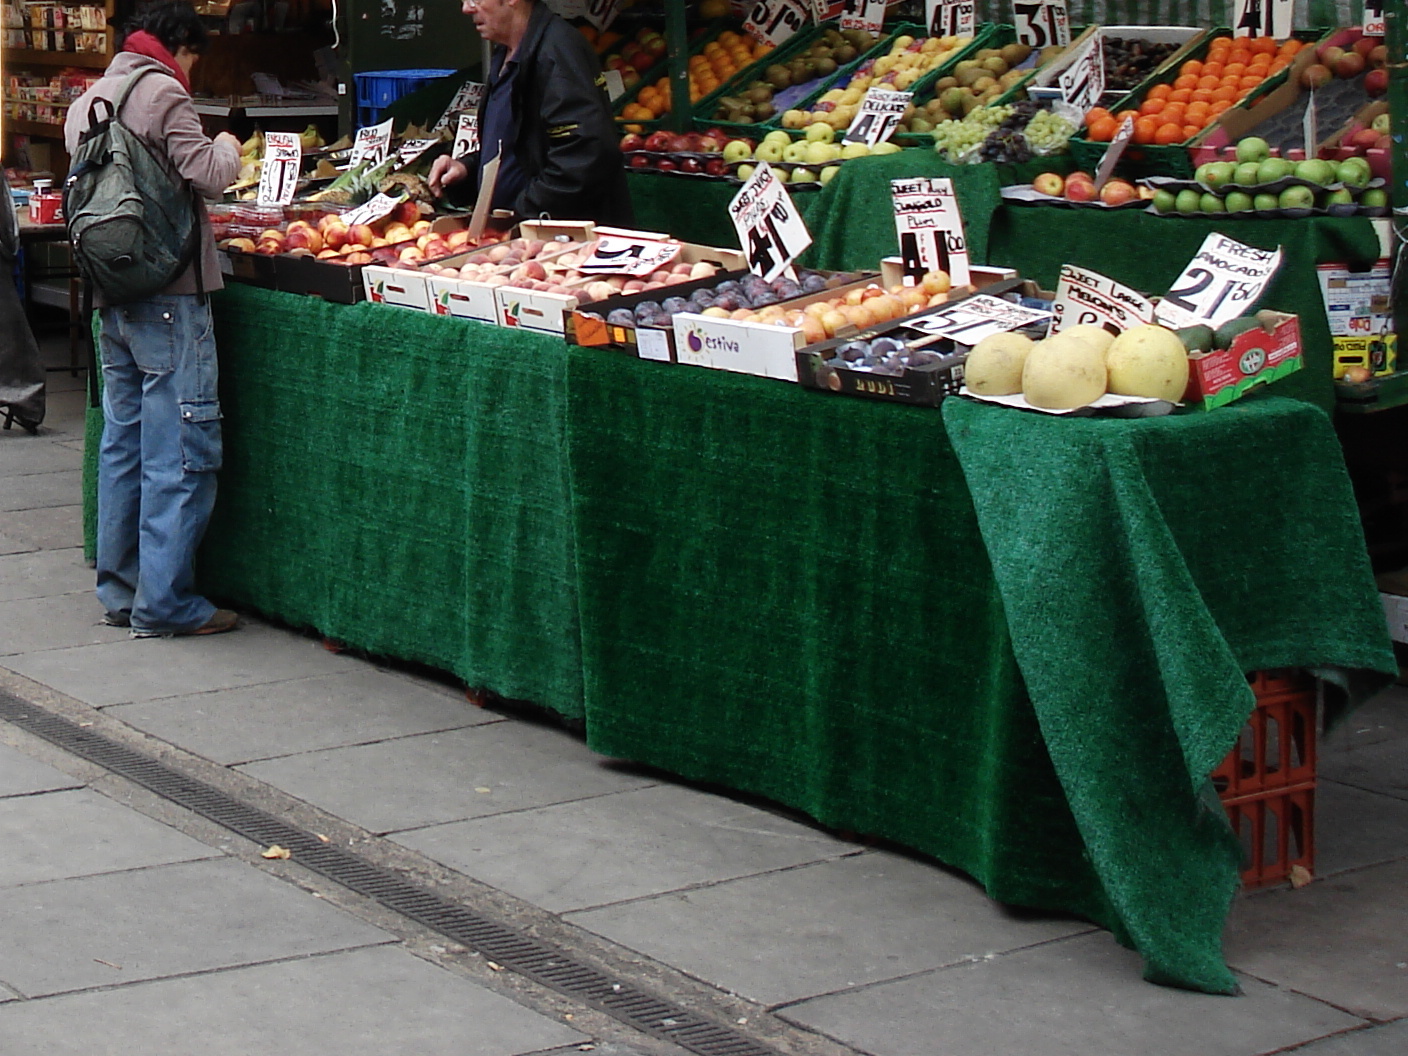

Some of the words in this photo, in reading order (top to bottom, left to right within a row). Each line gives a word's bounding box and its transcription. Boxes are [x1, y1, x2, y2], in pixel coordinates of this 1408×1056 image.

[892, 183, 922, 194] SWEET
[1216, 238, 1274, 264] FRESH
[705, 336, 740, 353] estiva
